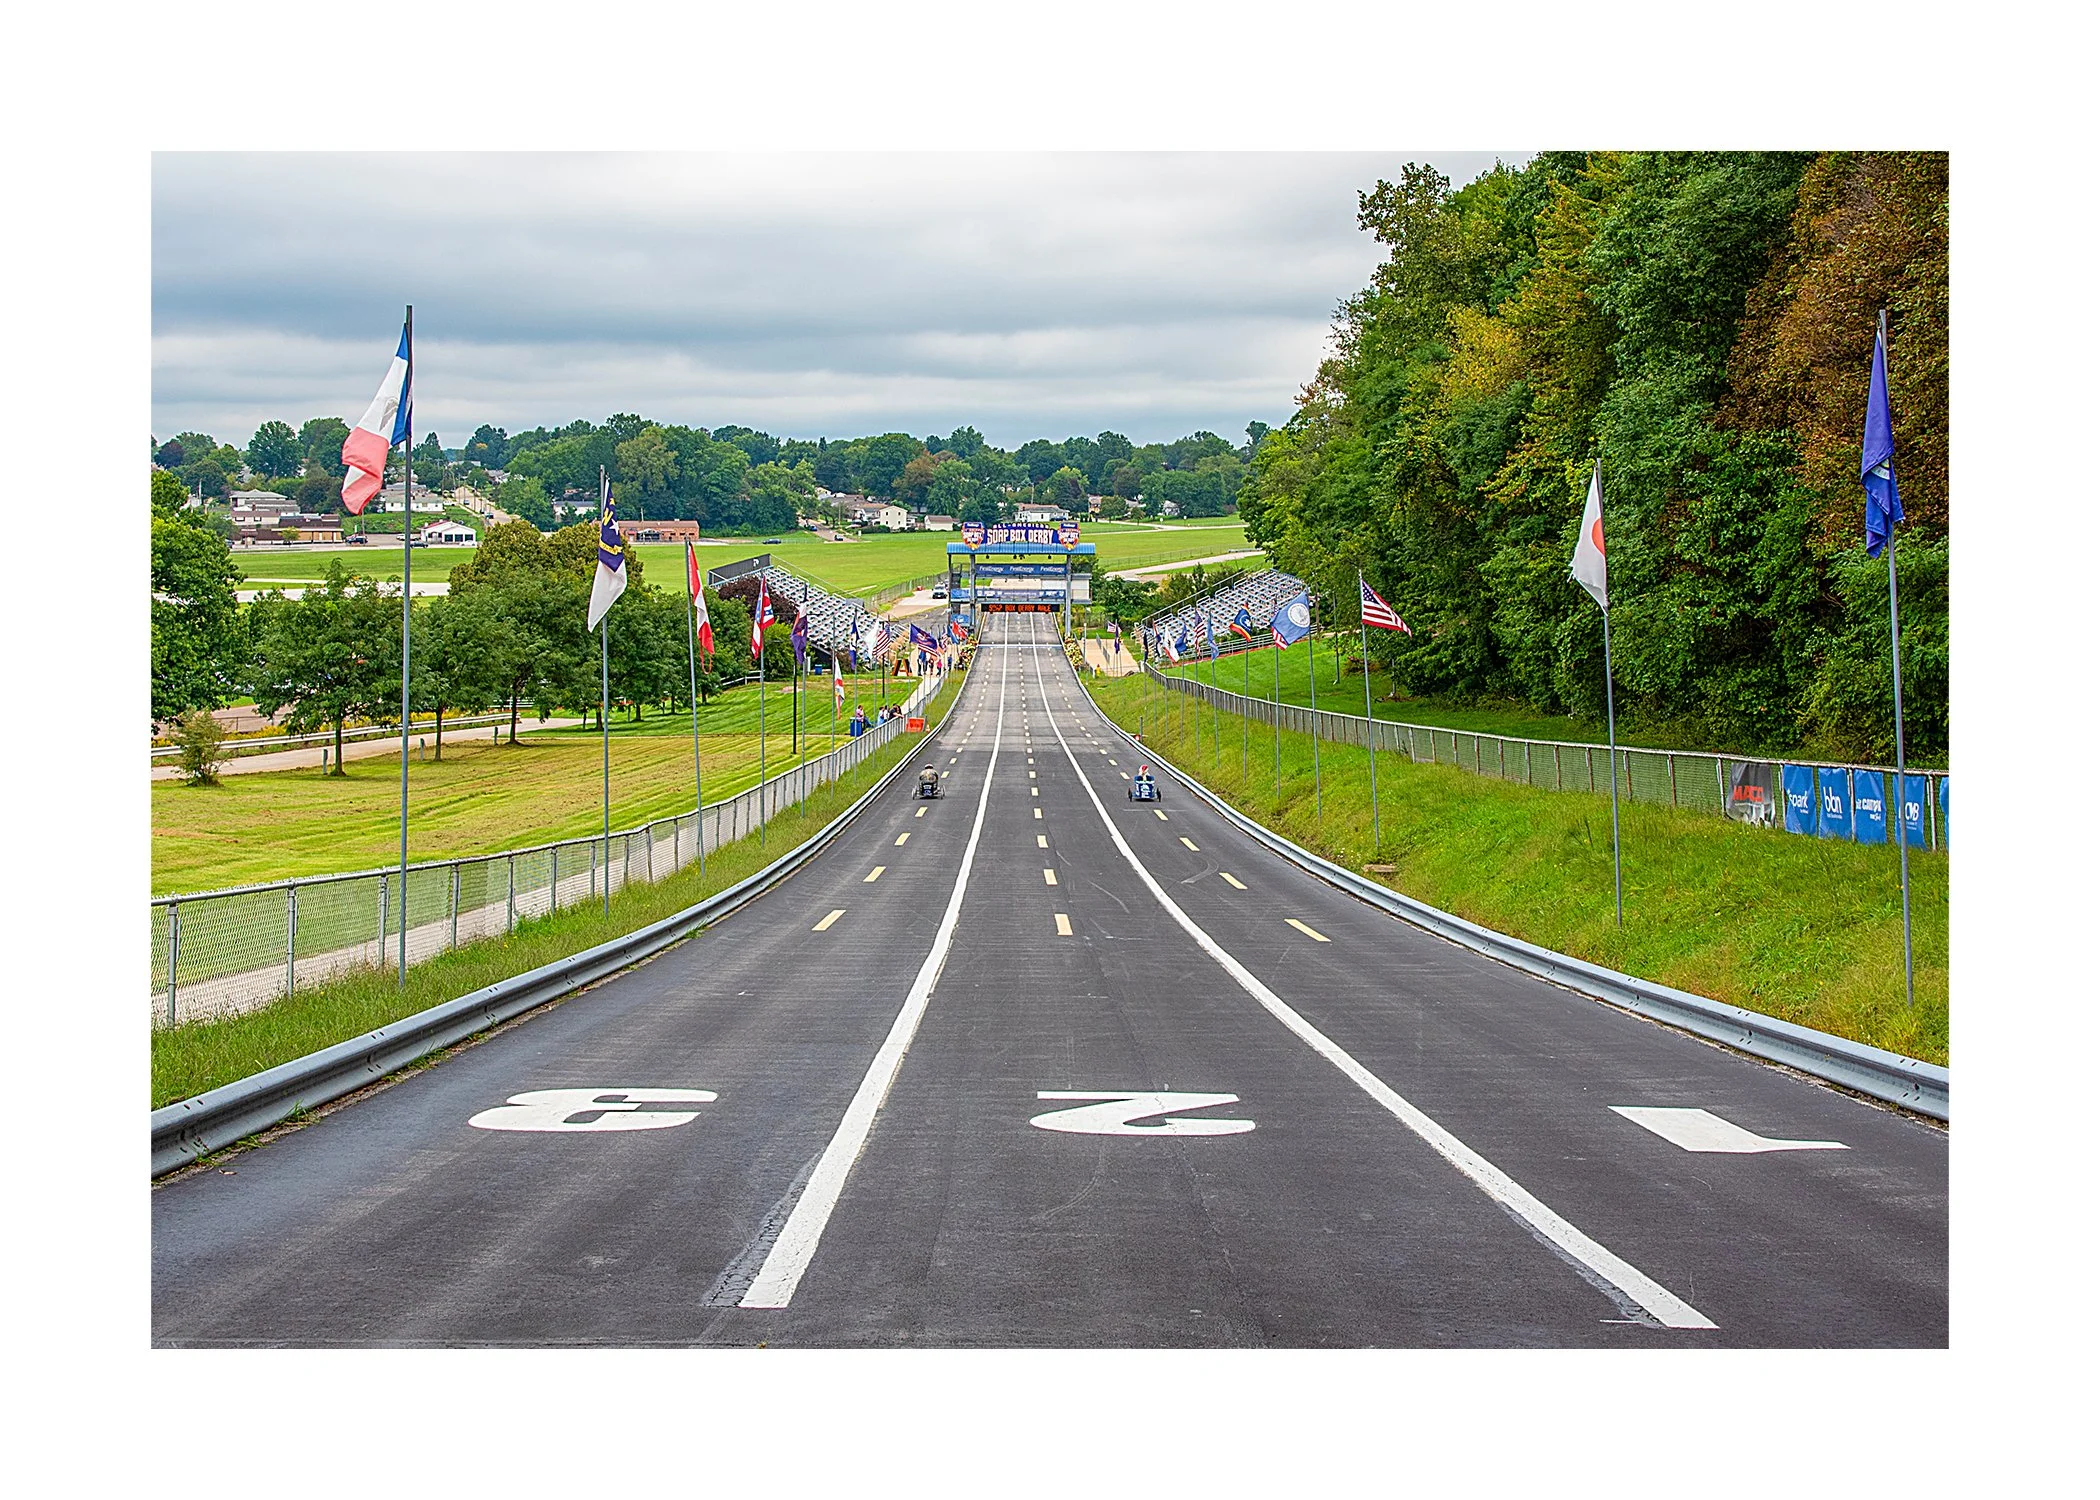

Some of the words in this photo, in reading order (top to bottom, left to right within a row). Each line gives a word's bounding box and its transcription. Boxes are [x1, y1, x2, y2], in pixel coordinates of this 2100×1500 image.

[987, 529, 1009, 545] SOAP
[1010, 529, 1026, 541] BOX
[1028, 529, 1054, 544] DERBY
[468, 1087, 718, 1132] 3
[1029, 1090, 1256, 1136] 2
